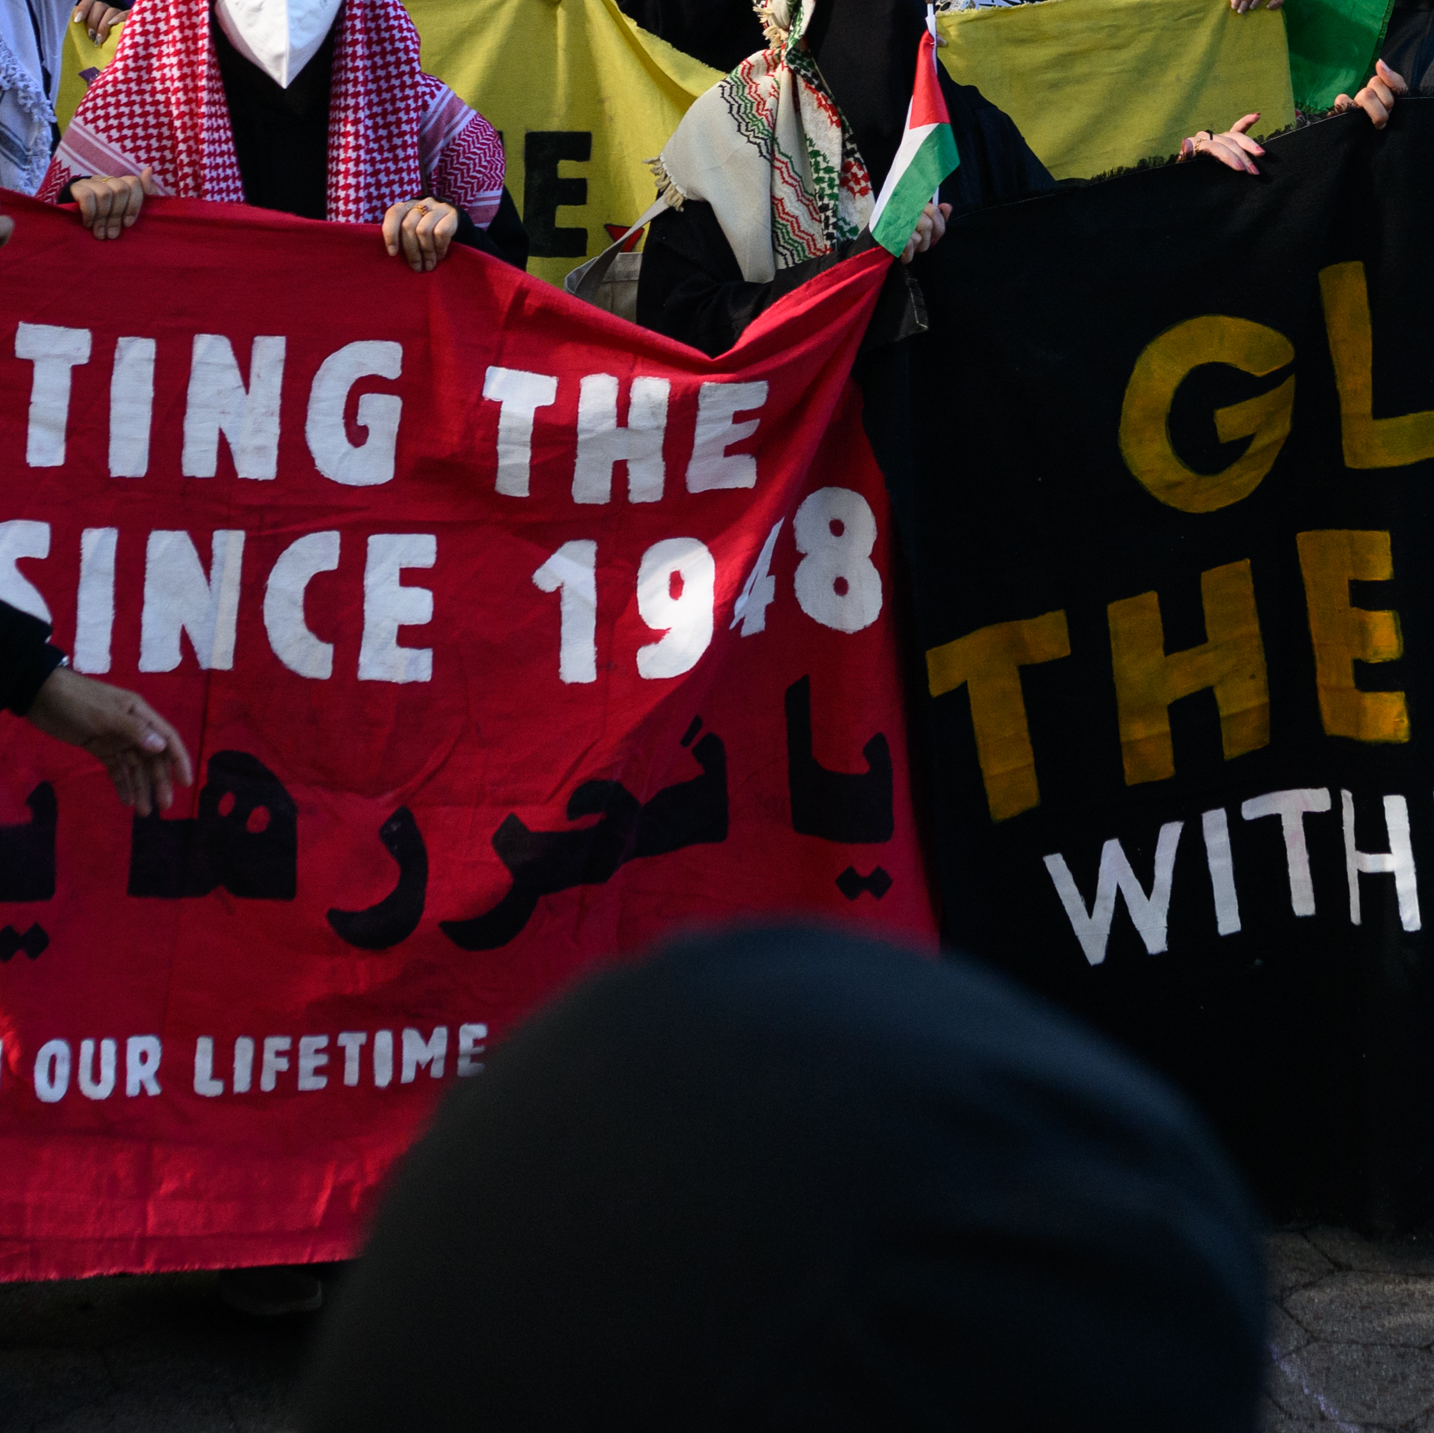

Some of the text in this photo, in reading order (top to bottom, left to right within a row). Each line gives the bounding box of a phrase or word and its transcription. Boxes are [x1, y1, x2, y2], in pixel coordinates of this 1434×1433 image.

[480, 365, 768, 504] THE
[924, 529, 1411, 823] THE
[34, 1034, 162, 1104] OUR
[193, 1022, 489, 1097] LIFETIME
